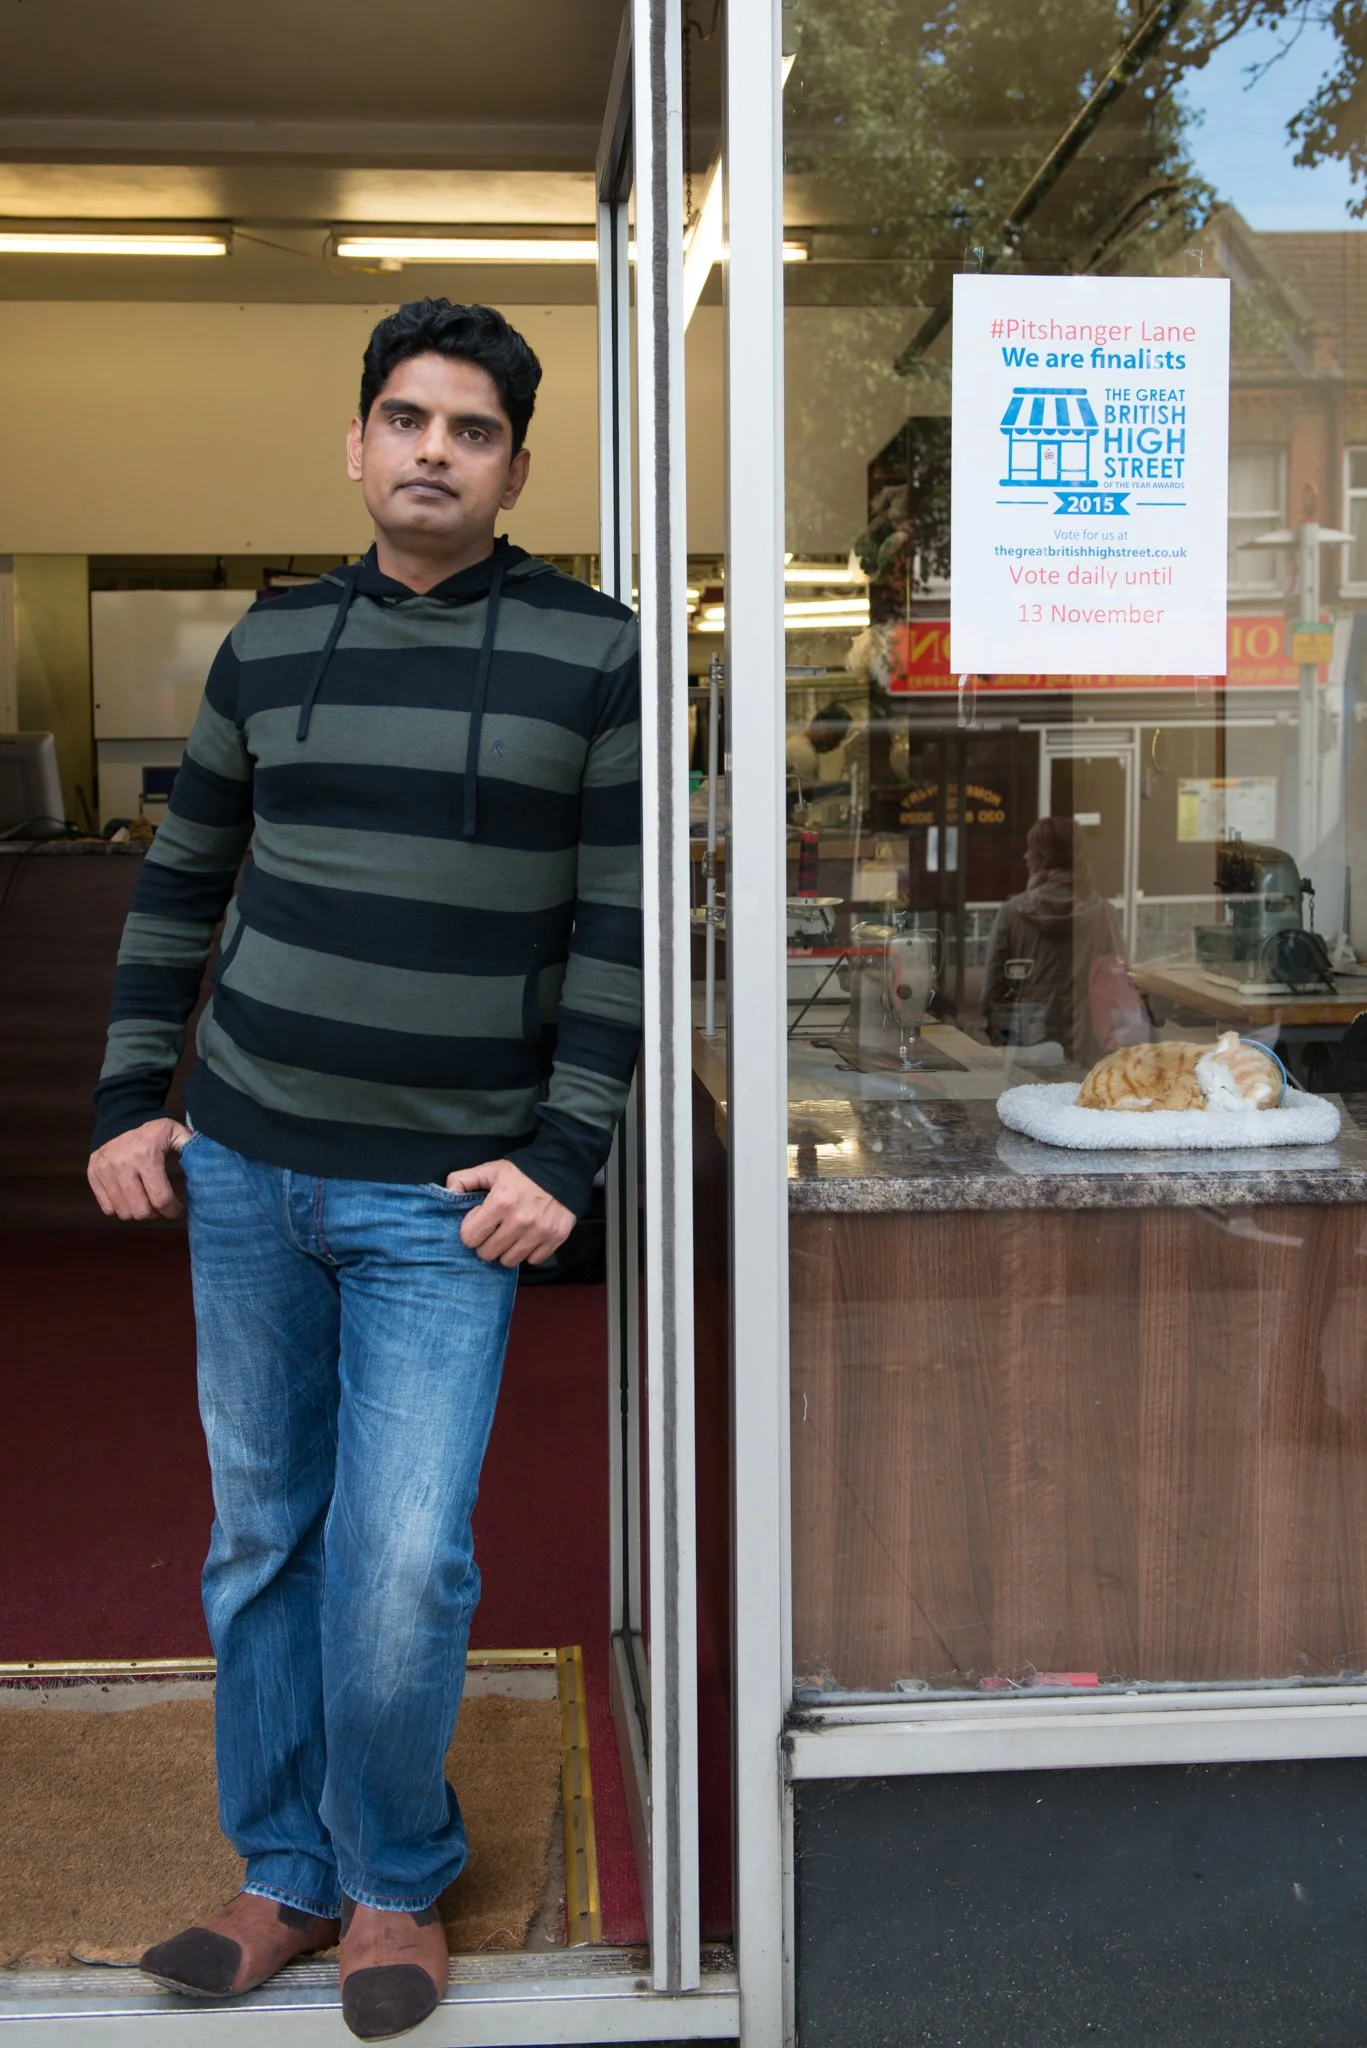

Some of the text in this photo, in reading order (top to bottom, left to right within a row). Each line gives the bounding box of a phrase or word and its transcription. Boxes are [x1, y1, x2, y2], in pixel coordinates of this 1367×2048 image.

[990, 319, 1196, 346] #Pitshanger Lane
[1001, 347, 1186, 370] We are finalists
[1105, 388, 1185, 402] THE GREAT
[1104, 405, 1185, 424] BRITISH
[1104, 428, 1185, 454] HIGH
[1104, 457, 1185, 478] STREET
[1066, 496, 1115, 513] 2015
[1053, 529, 1129, 541] Vote for us at
[994, 545, 1187, 559] thegreatbritishhighstreet.co.uk
[1009, 565, 1172, 589] Vote daily until
[1018, 604, 1165, 624] 13 November
